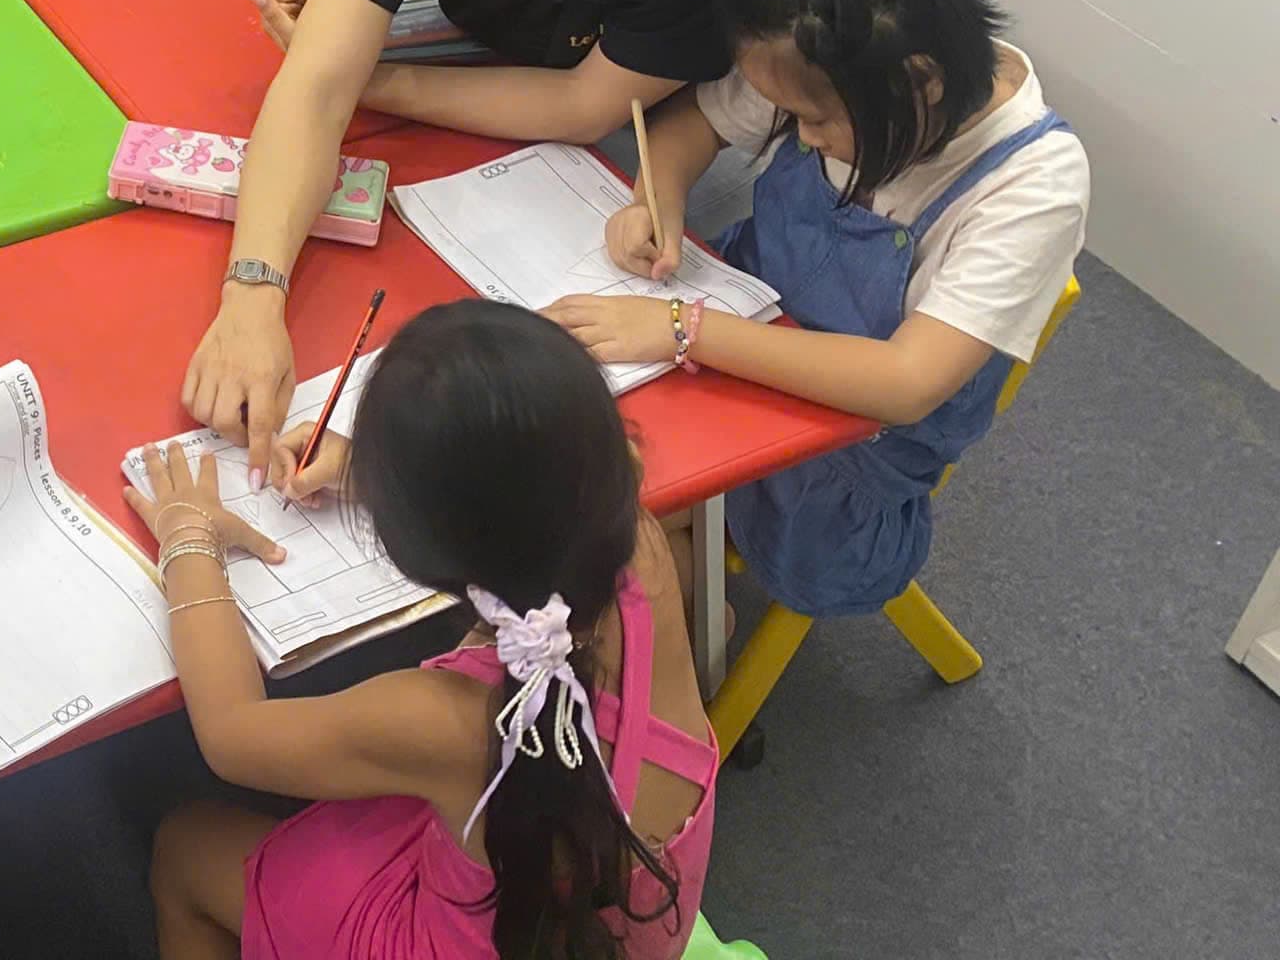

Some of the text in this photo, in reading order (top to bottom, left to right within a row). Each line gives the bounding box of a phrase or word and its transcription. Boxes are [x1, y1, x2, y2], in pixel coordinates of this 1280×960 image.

[16, 373, 37, 407] UNIT
[33, 426, 42, 461] Places
[40, 472, 62, 507] lesson
